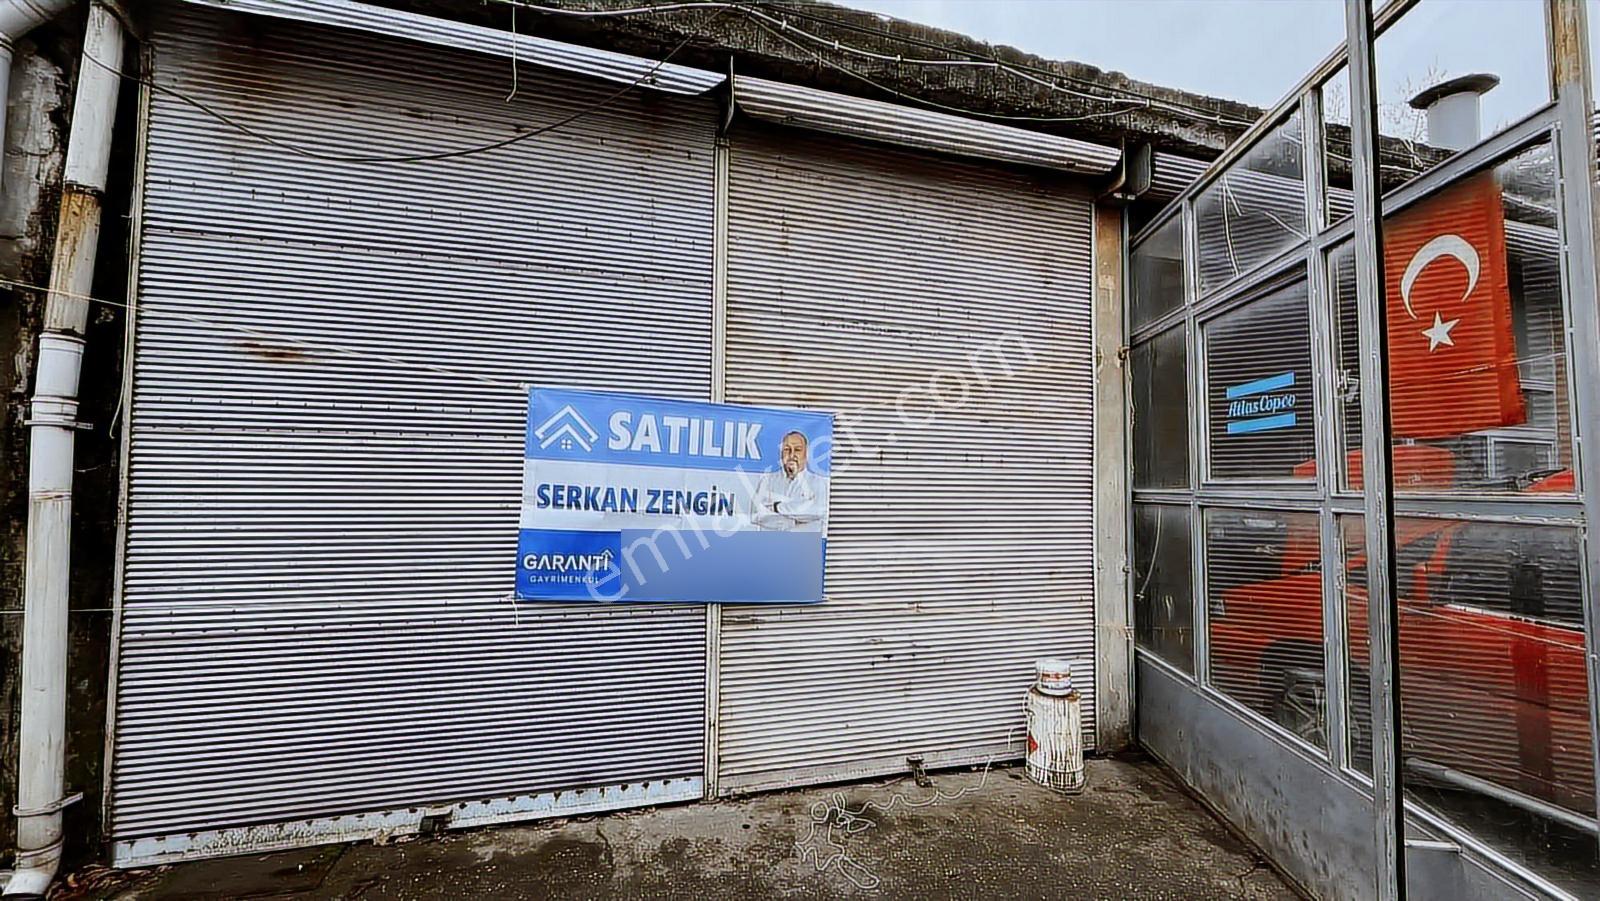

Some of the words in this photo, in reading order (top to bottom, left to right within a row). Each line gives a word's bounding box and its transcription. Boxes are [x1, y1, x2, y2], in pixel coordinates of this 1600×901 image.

[607, 410, 764, 461] SATILIK
[537, 483, 638, 513] SERKAN
[645, 485, 735, 517] ZENGİN
